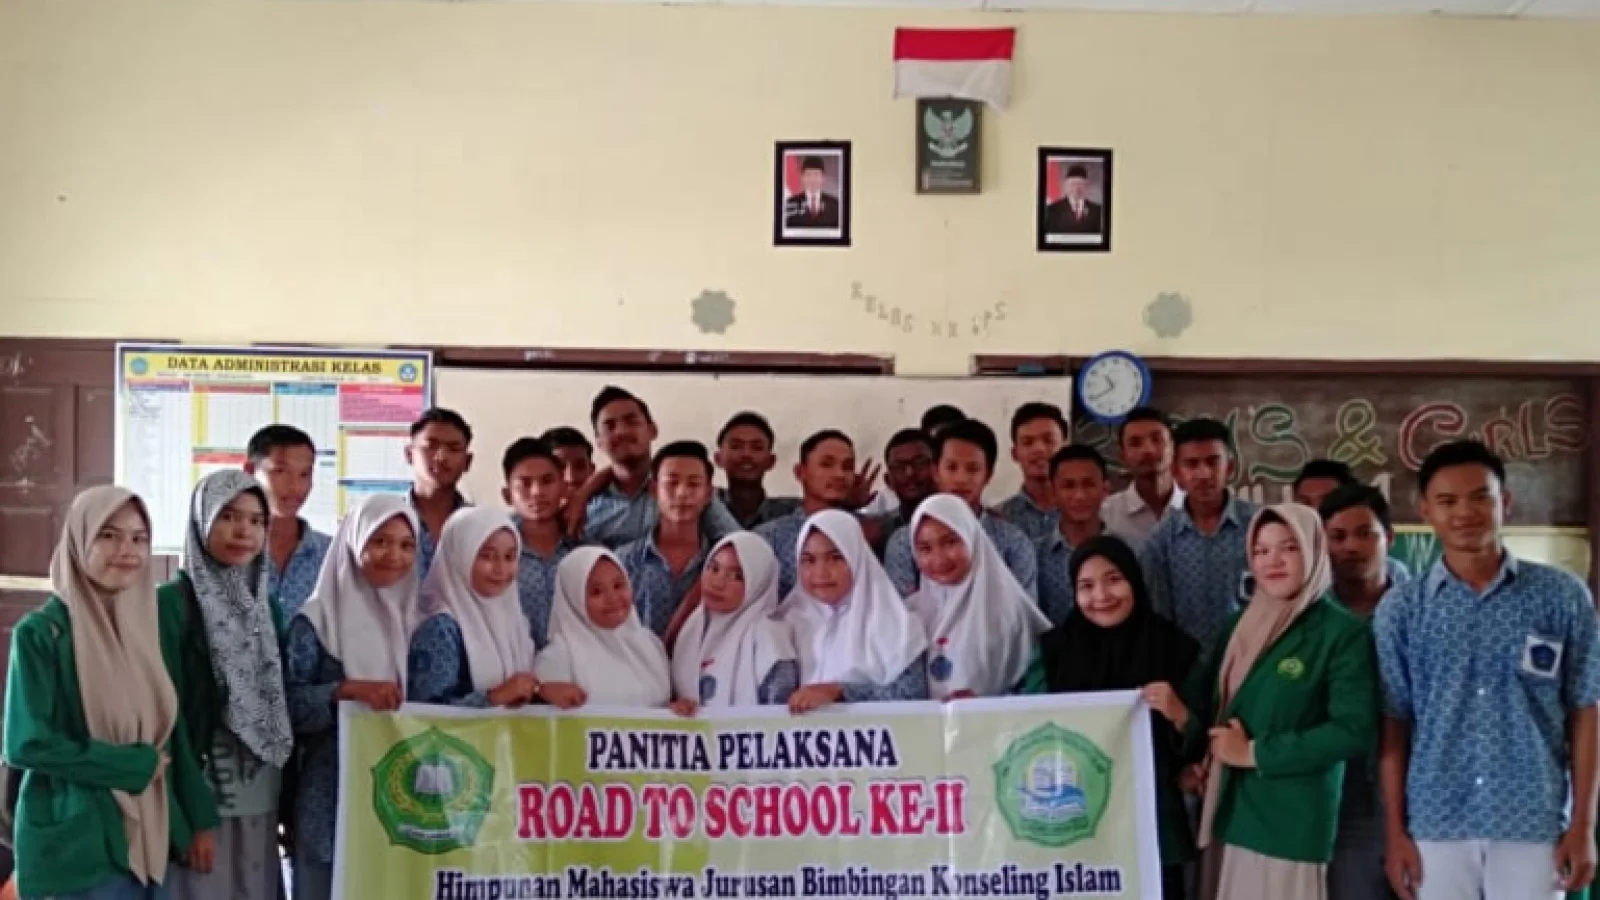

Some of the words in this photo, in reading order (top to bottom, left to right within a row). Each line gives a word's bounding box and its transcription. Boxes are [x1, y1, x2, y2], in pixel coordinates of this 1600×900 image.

[167, 356, 208, 370] DATA
[213, 358, 325, 372] ADMINISTRASI
[332, 361, 382, 374] KELAS
[587, 730, 711, 770] PANITIA
[718, 728, 898, 769] PELAKSANA
[518, 785, 634, 839] ROAD
[643, 785, 696, 838] TO
[704, 784, 861, 838] SCHOOL
[869, 782, 966, 835] KE-II
[436, 871, 561, 900] Himpunan
[567, 868, 695, 900] Mahasiswa
[700, 869, 796, 900] Jurusan
[801, 867, 925, 900] Bimbingan
[1054, 862, 1122, 893] Islam
